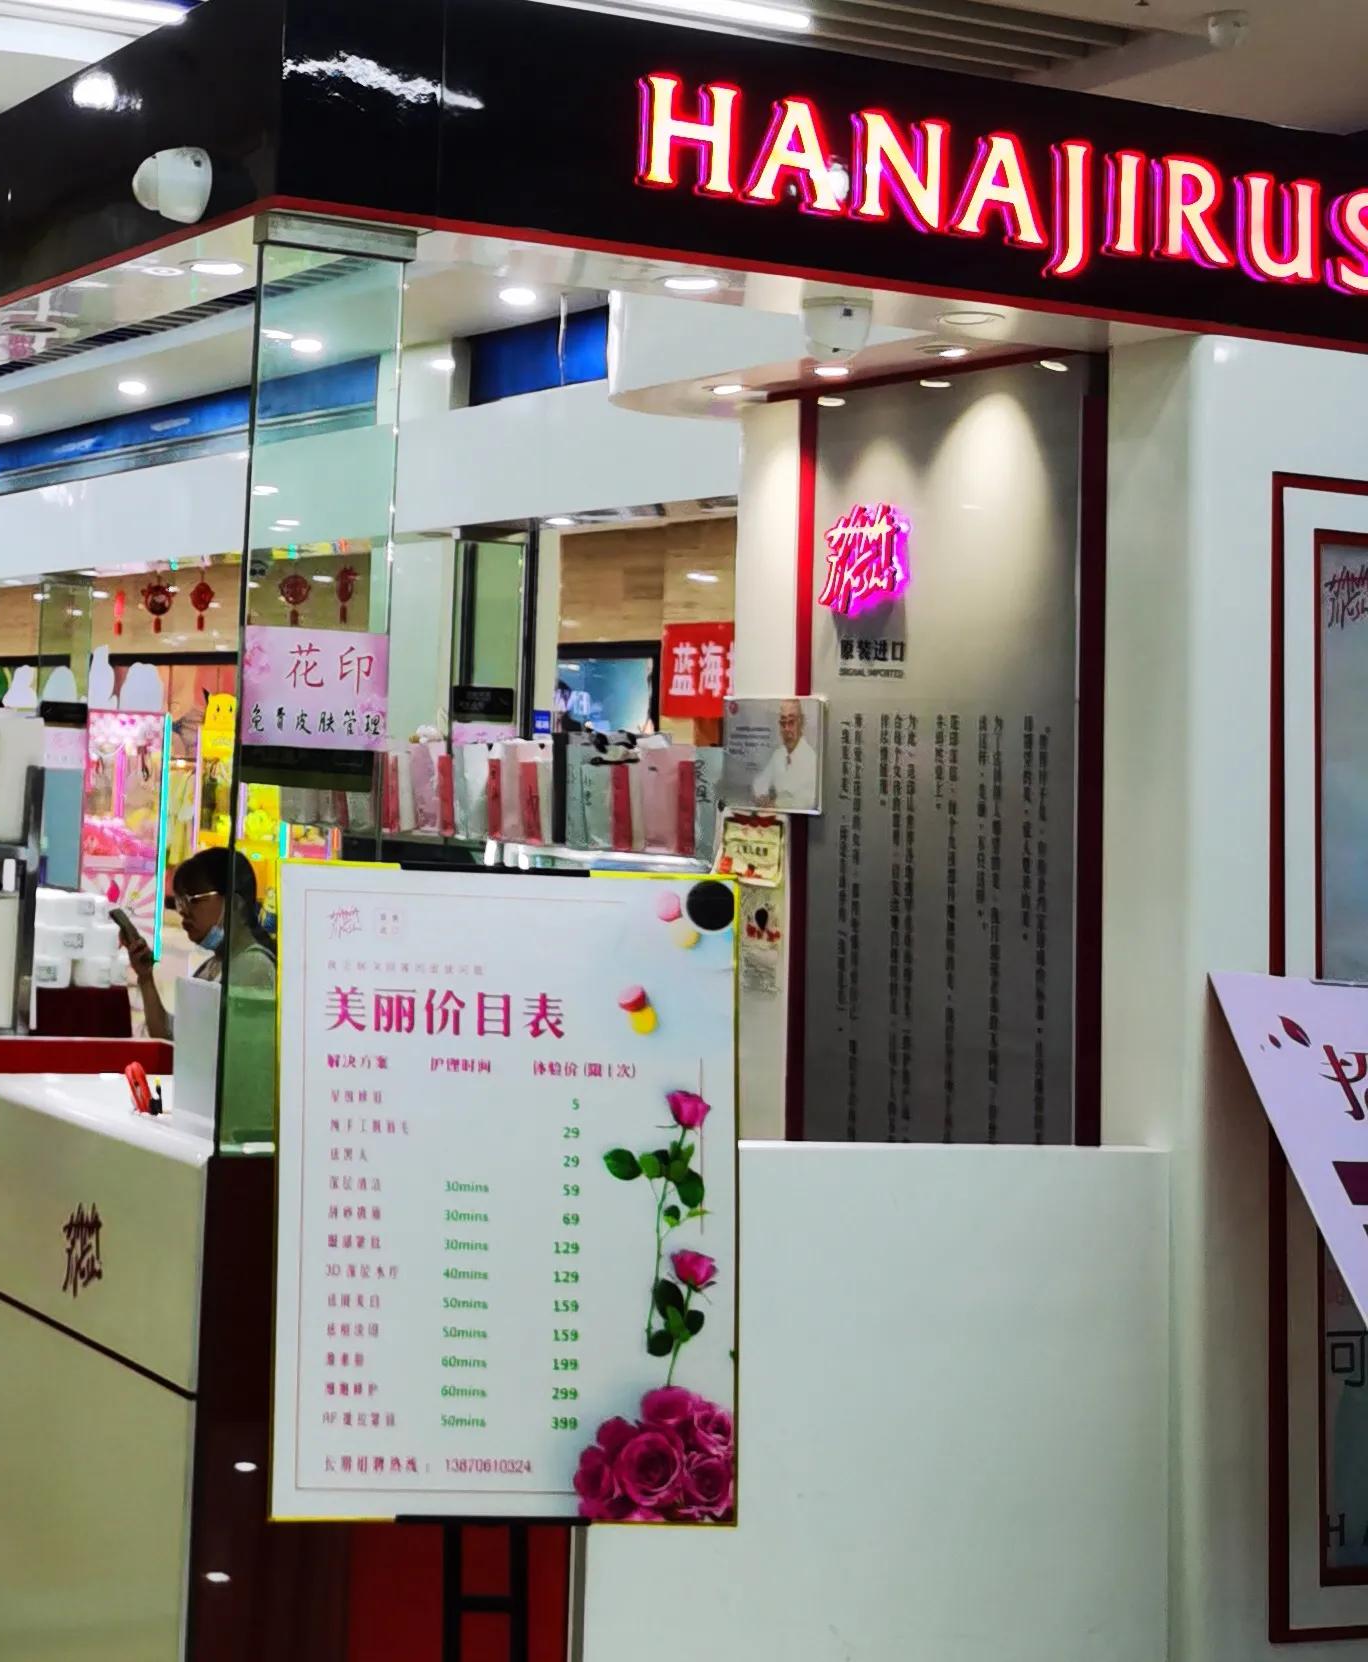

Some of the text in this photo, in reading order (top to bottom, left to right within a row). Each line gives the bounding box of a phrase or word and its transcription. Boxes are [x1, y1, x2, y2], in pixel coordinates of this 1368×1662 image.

[840, 638, 906, 663] 原装进口
[285, 642, 374, 696] 花印
[668, 640, 734, 697] 蓝海
[325, 986, 566, 1040] 美丽价目表
[327, 1053, 388, 1071] 解决方案
[430, 1056, 492, 1075] 护理时间
[571, 1098, 580, 1111] 5
[562, 1126, 580, 1139] 29
[562, 1155, 580, 1168] 29
[562, 1184, 580, 1197] 59
[562, 1213, 580, 1226] 69
[553, 1241, 580, 1254] 129
[552, 1270, 580, 1283] 129
[552, 1299, 579, 1312] 159
[552, 1329, 579, 1342] 159
[552, 1358, 579, 1371] 199
[552, 1387, 579, 1400] 299
[551, 1417, 578, 1430] 399
[445, 1458, 532, 1475] 13870610324
